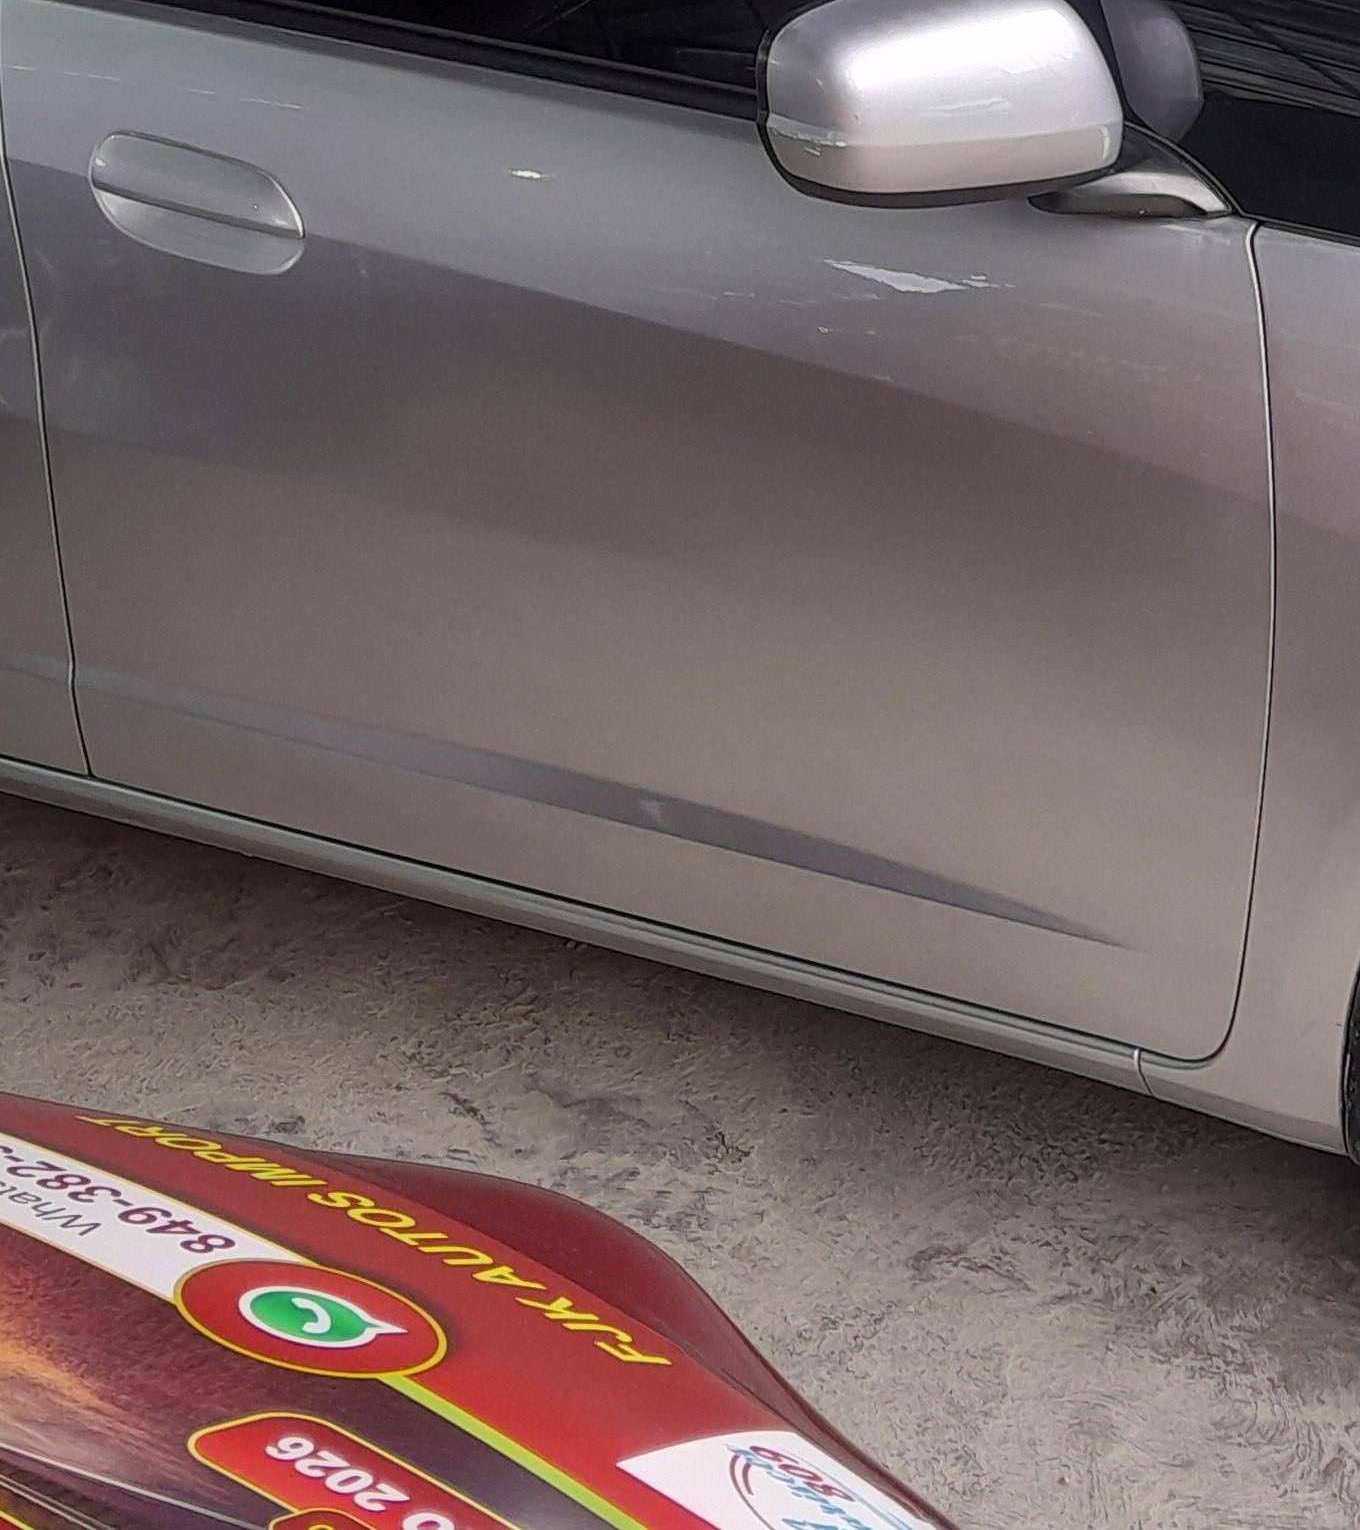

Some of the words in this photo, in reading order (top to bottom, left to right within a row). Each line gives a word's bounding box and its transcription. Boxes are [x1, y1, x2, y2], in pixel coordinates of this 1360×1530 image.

[75, 1115, 327, 1187] IMPORT
[308, 1191, 545, 1290] AUTOS
[515, 1296, 671, 1366] FJK
[265, 1436, 411, 1512] 2026
